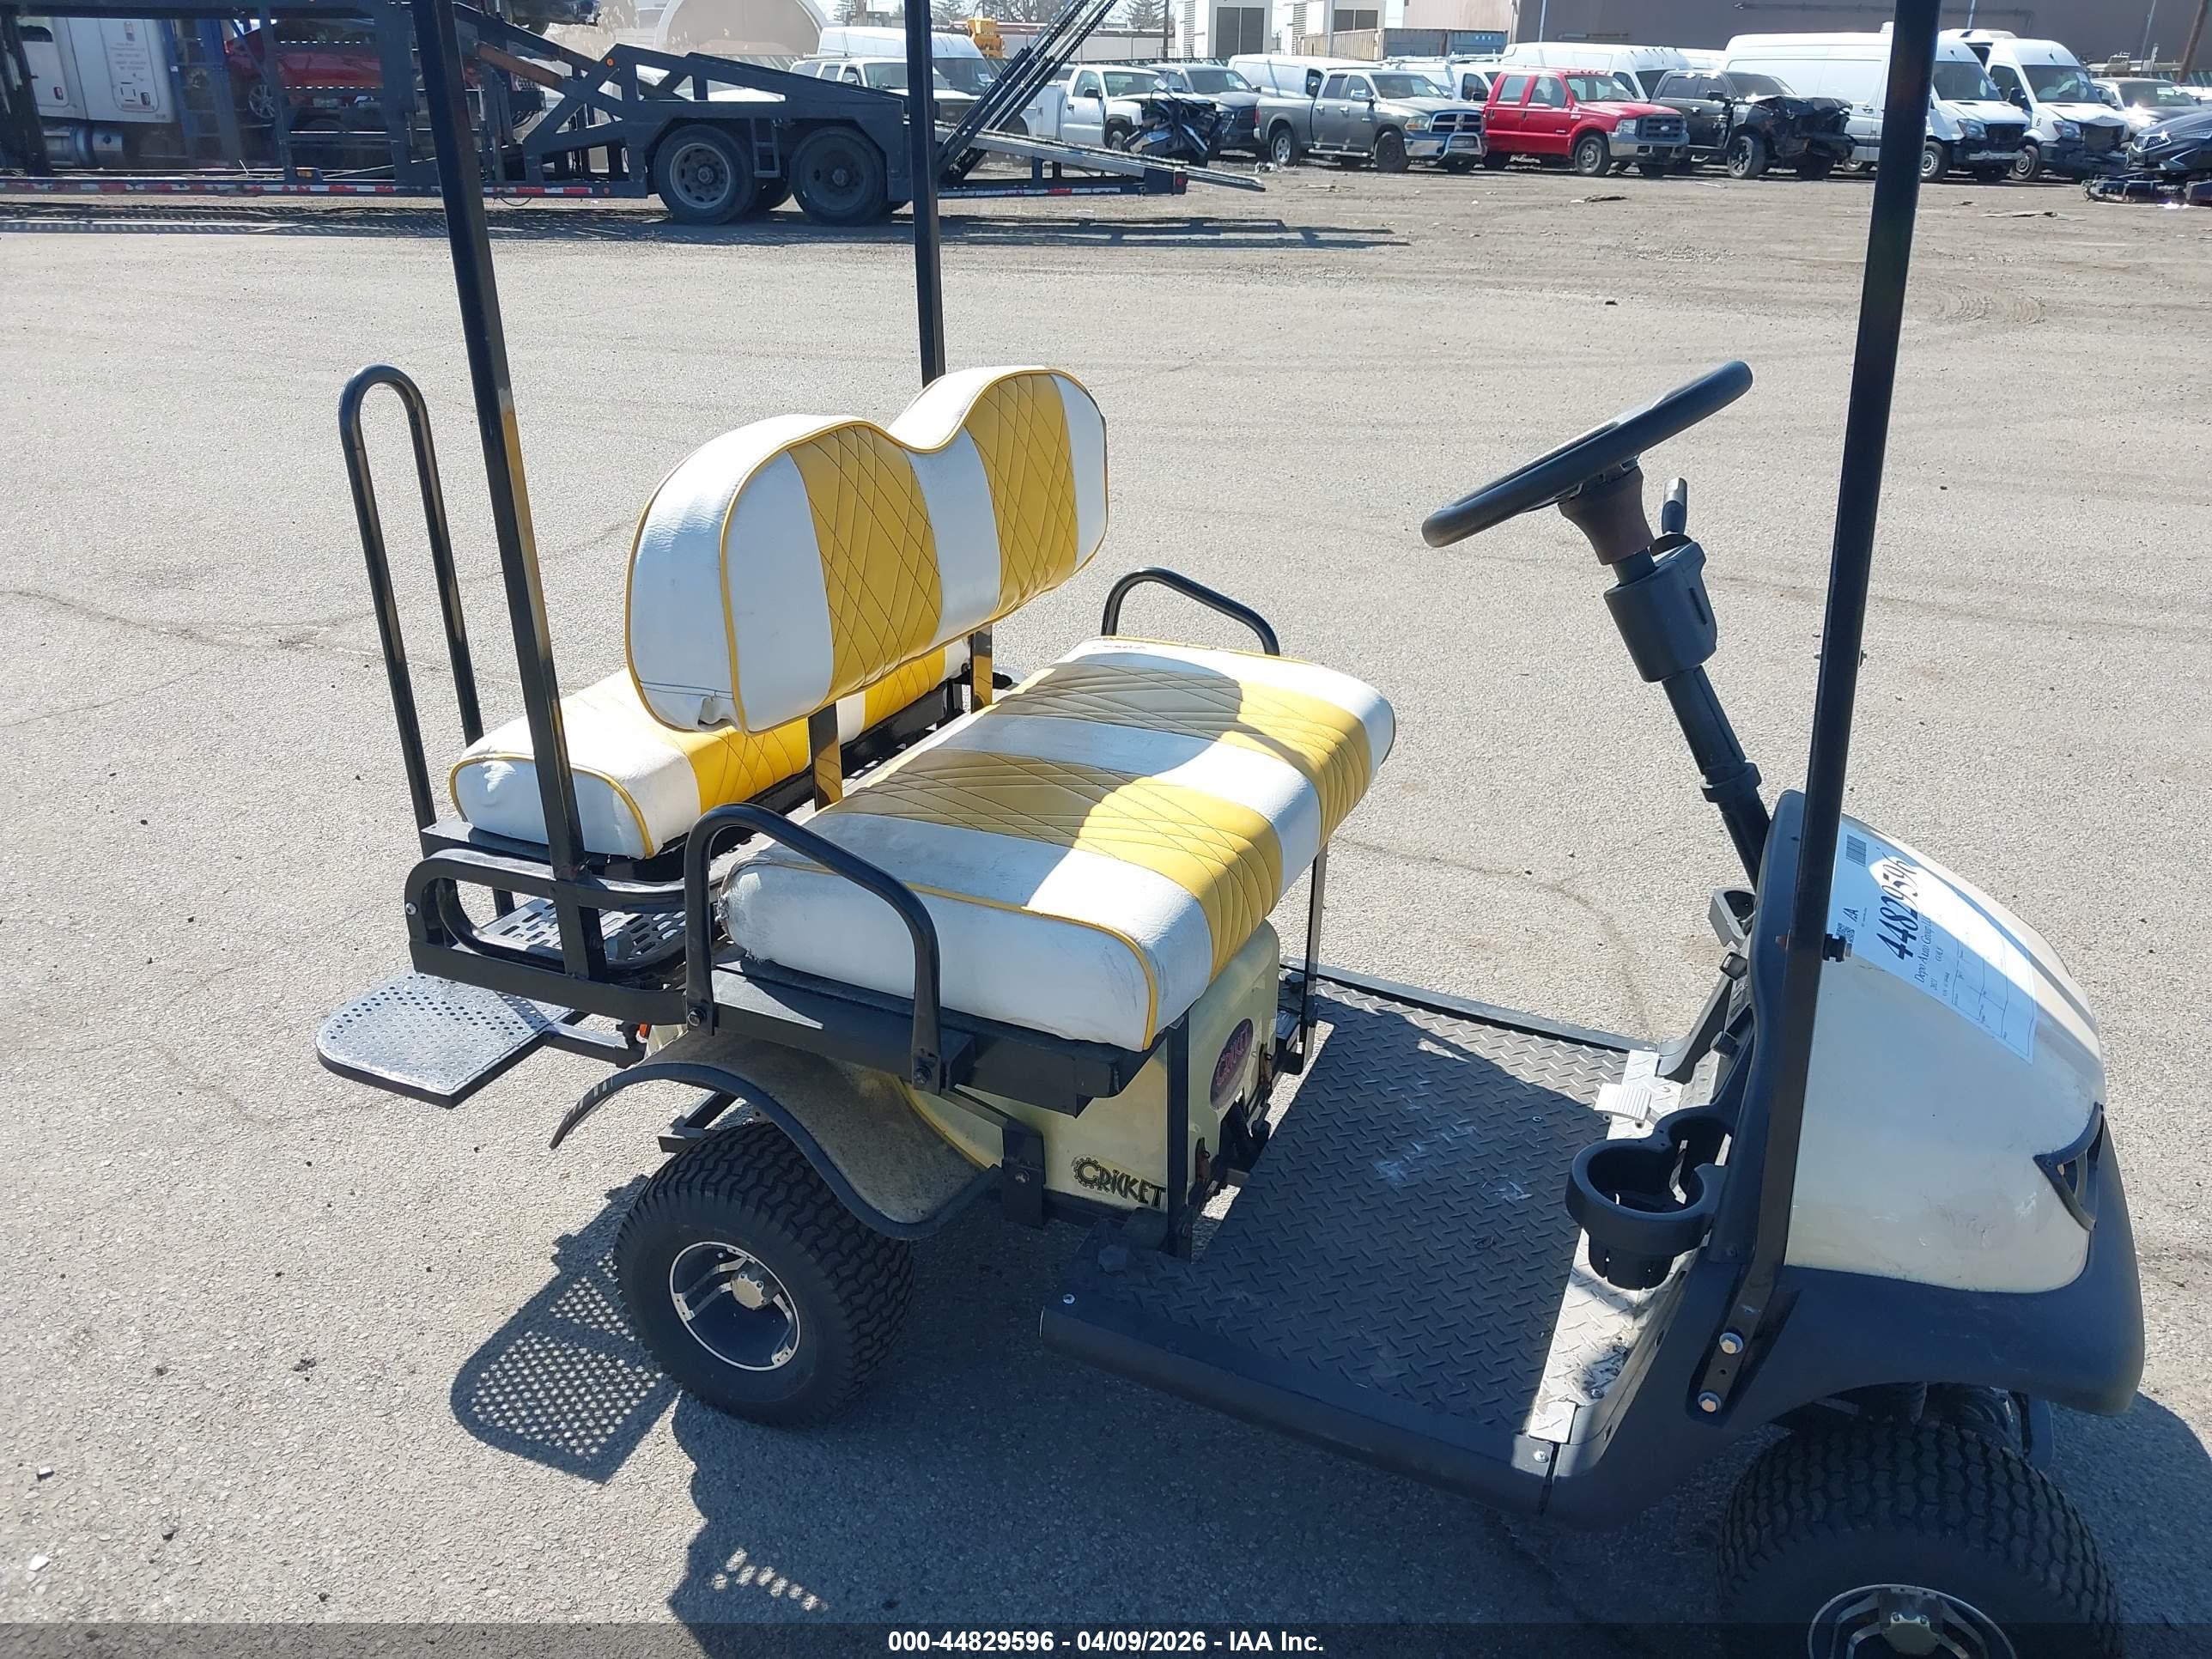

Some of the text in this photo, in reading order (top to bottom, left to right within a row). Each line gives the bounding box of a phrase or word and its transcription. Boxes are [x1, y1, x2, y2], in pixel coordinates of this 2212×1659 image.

[1877, 851, 1918, 960] 44829596
[1922, 924, 1936, 945] Group
[1917, 945, 1930, 963] Auto
